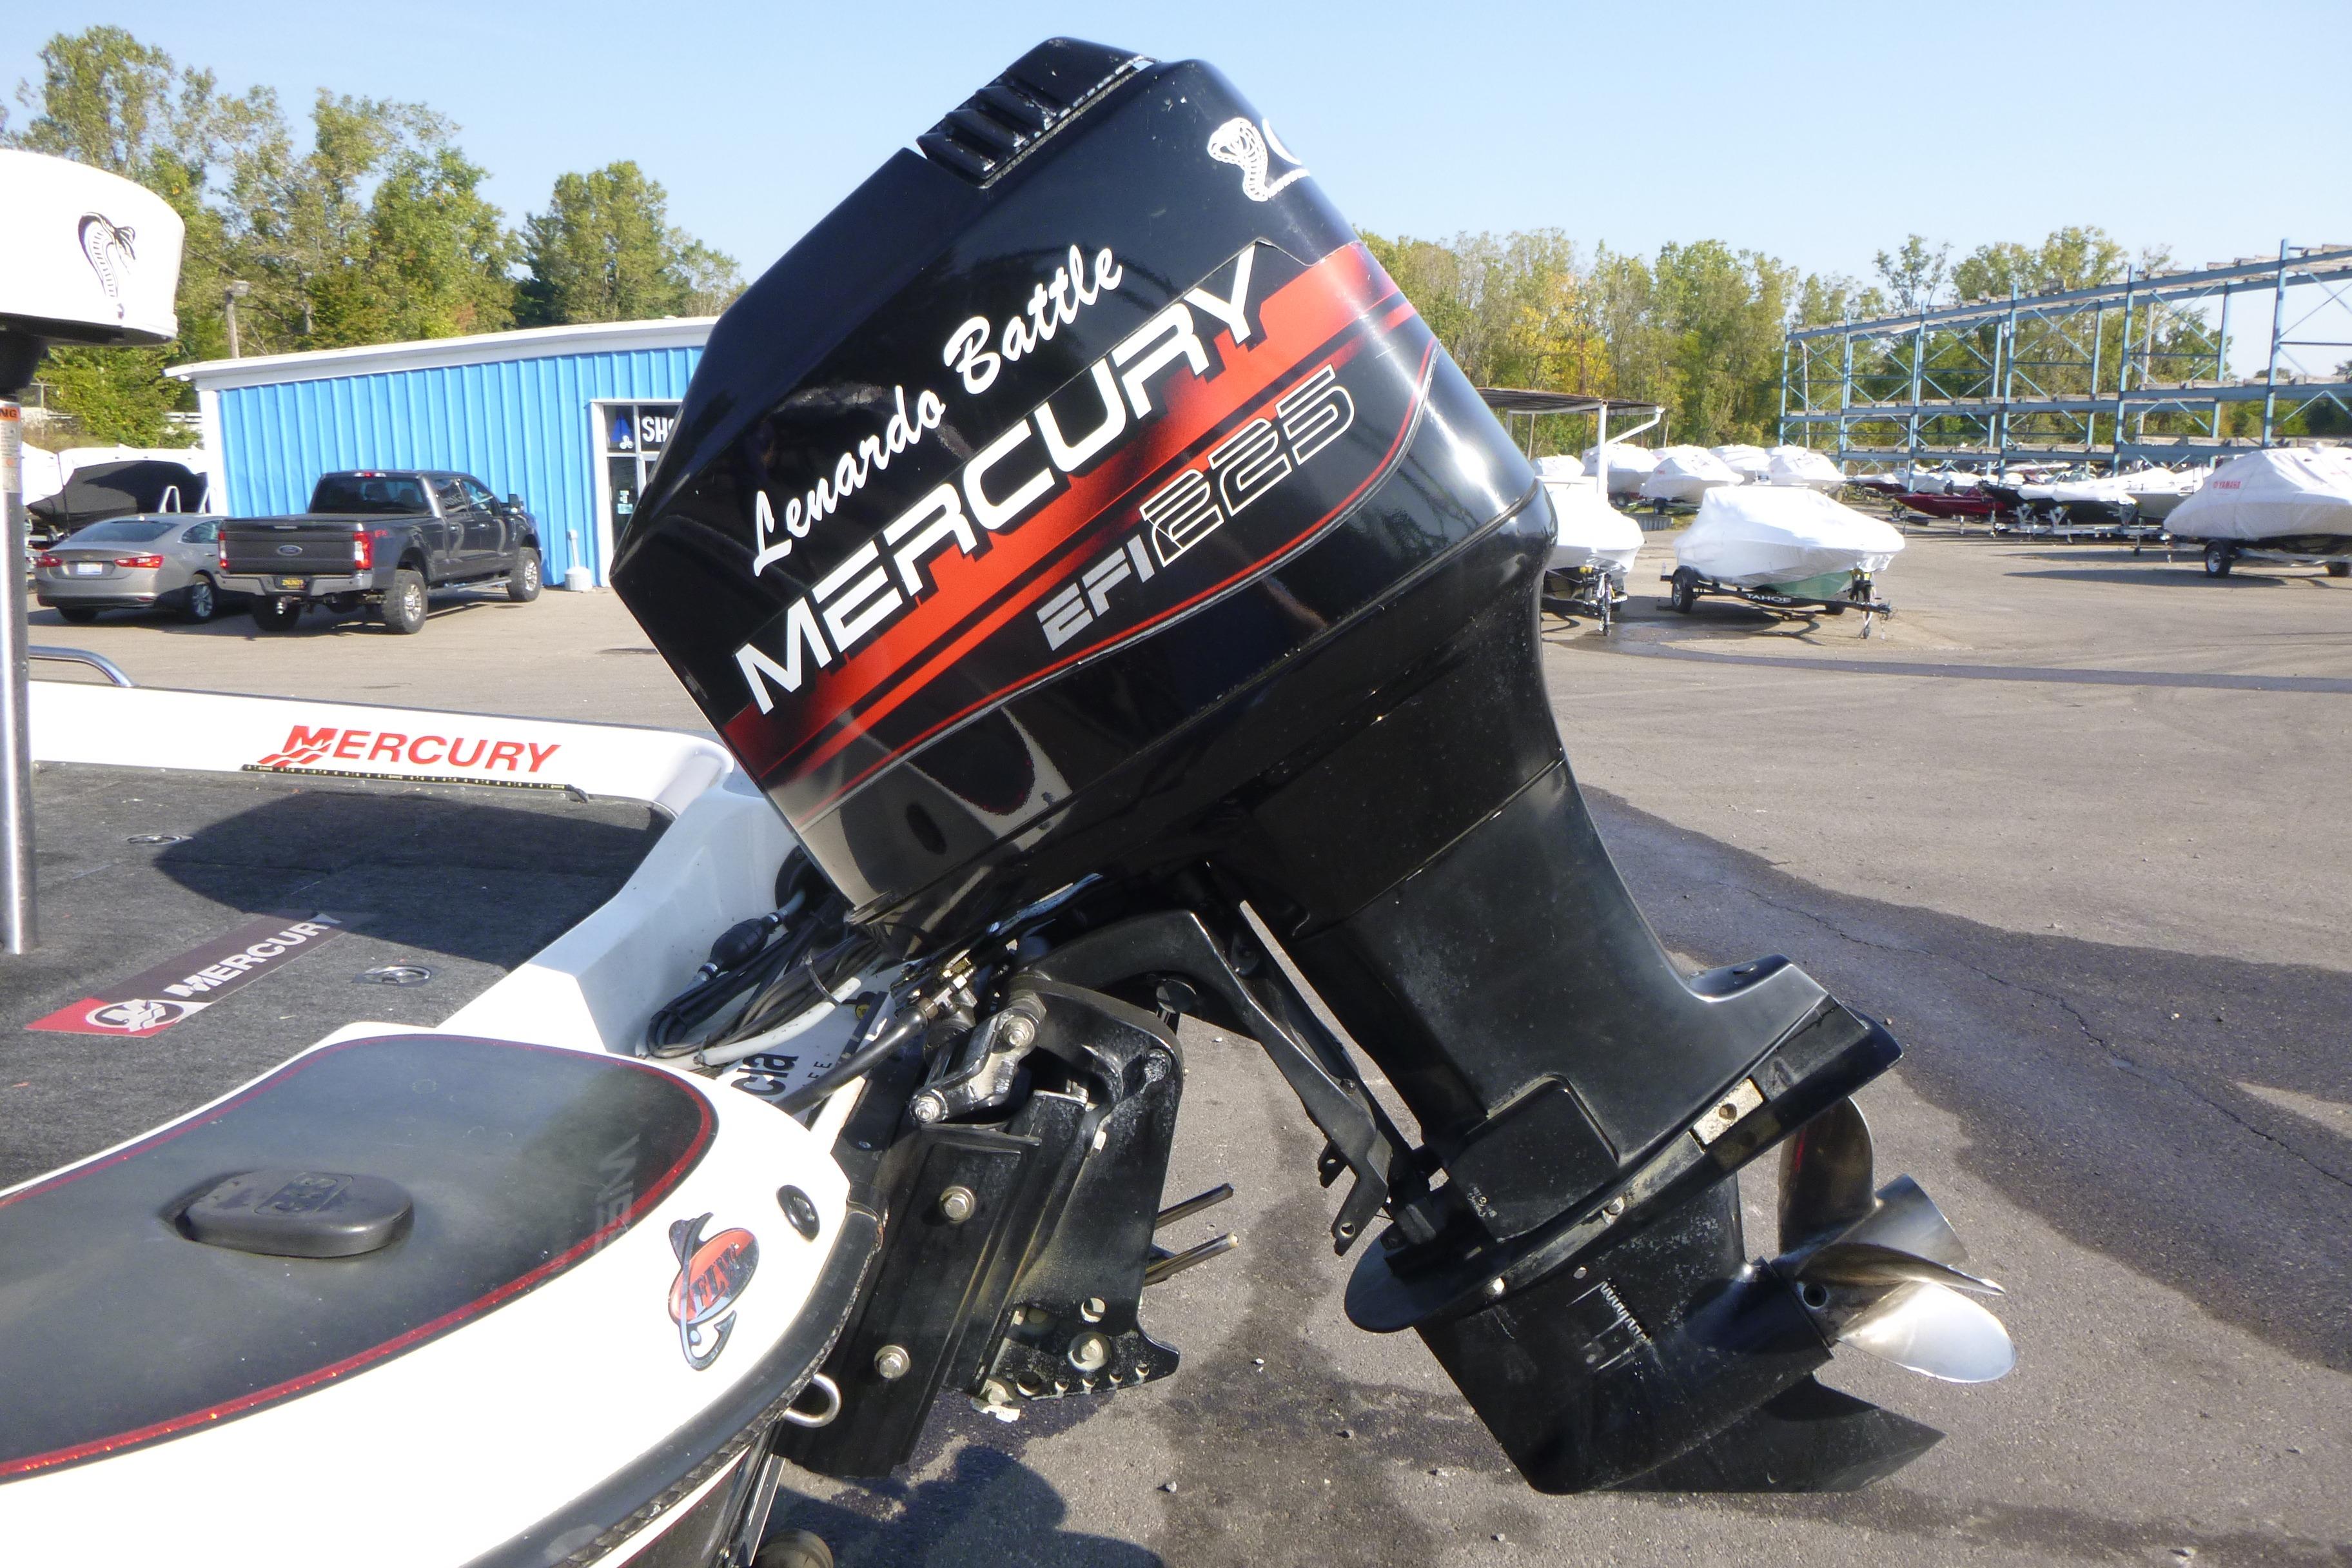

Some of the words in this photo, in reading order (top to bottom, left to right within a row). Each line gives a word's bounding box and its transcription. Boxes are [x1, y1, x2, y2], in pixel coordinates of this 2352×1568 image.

[735, 244, 1251, 715] MERCURY
[754, 385, 946, 576] Lenardo
[944, 244, 1122, 394] Battle
[1036, 534, 1155, 651] EFI
[1139, 364, 1355, 567] 225
[1746, 593, 1792, 603] TAHOE
[258, 725, 562, 772] MERCURY
[163, 912, 342, 997] MERCURY
